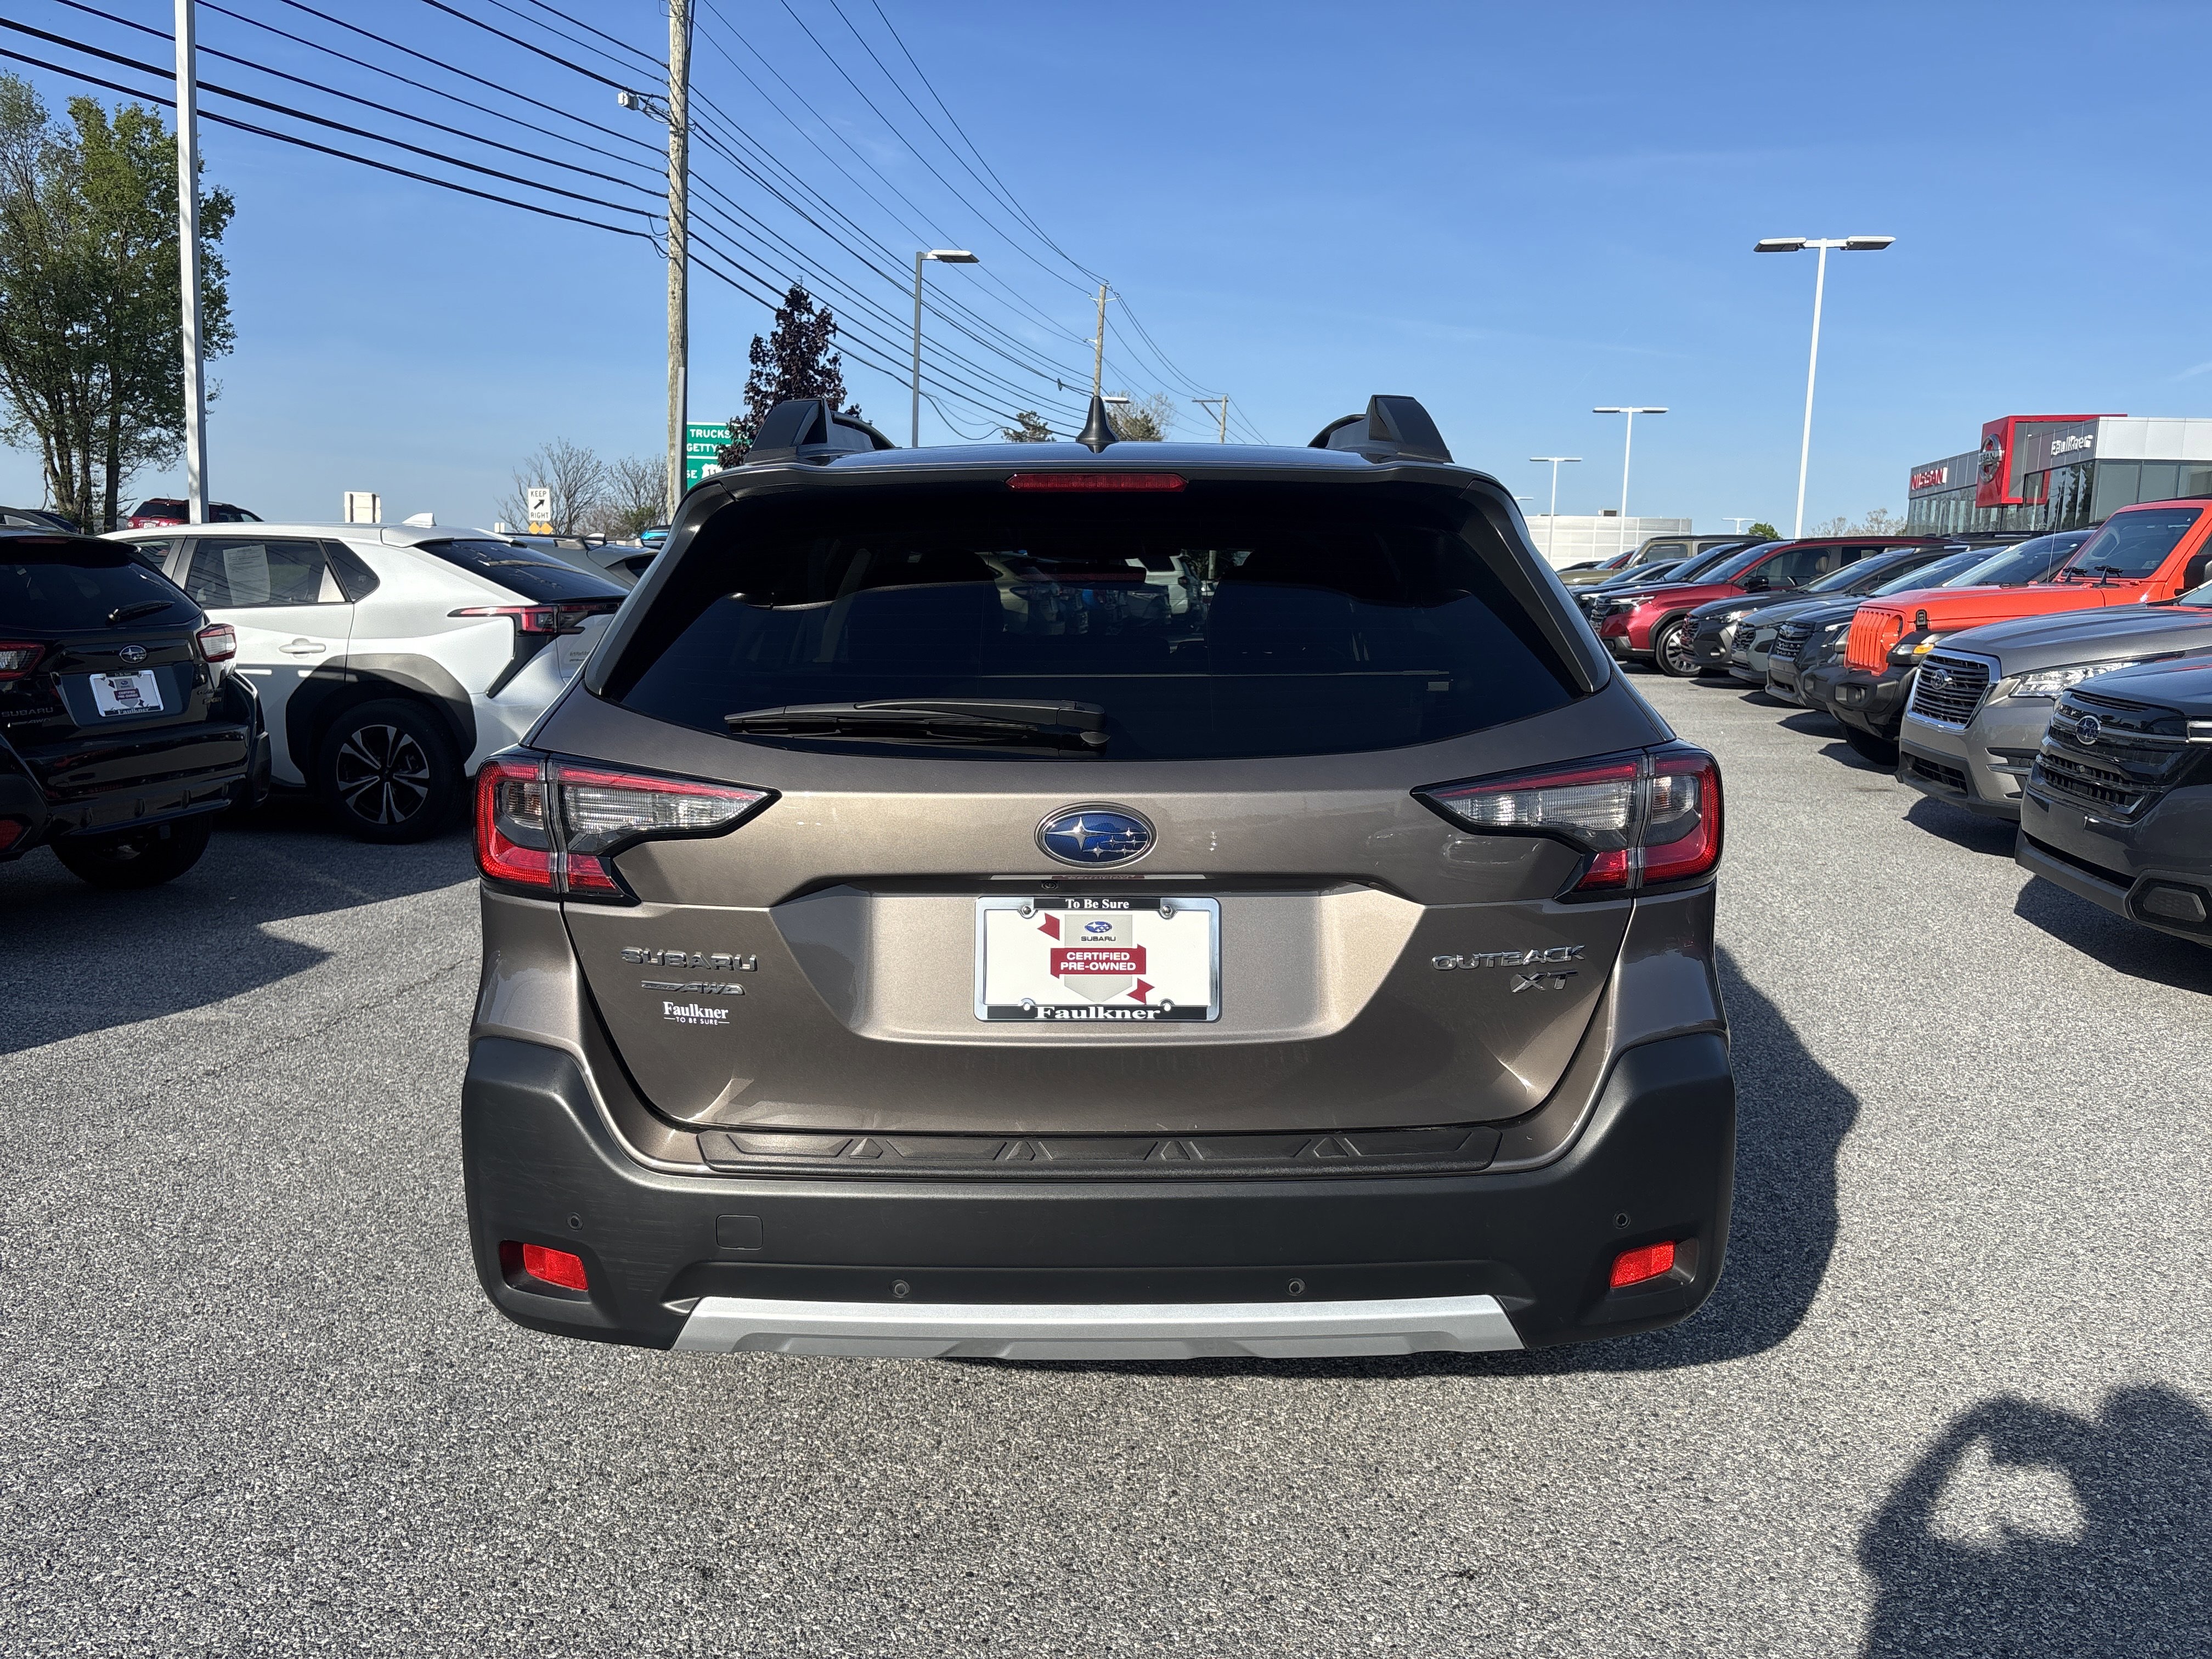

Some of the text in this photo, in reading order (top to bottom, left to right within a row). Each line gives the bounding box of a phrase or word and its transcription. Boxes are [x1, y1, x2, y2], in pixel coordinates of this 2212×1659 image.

[690, 429, 732, 439] TRUCKS
[2051, 435, 2093, 455] Faulkner
[2, 707, 53, 717] SUBARU
[1065, 899, 1130, 909] To Be Sure
[621, 946, 758, 972] SUBARU
[1066, 952, 1130, 961] CERTIFIED
[1431, 944, 1585, 970] OUTBACK
[1060, 962, 1136, 970] PRE-OWNED
[680, 981, 745, 995] AWD
[1511, 970, 1578, 993] XT
[663, 1001, 729, 1019] Faulkner
[1034, 1006, 1160, 1019] Faulkner
